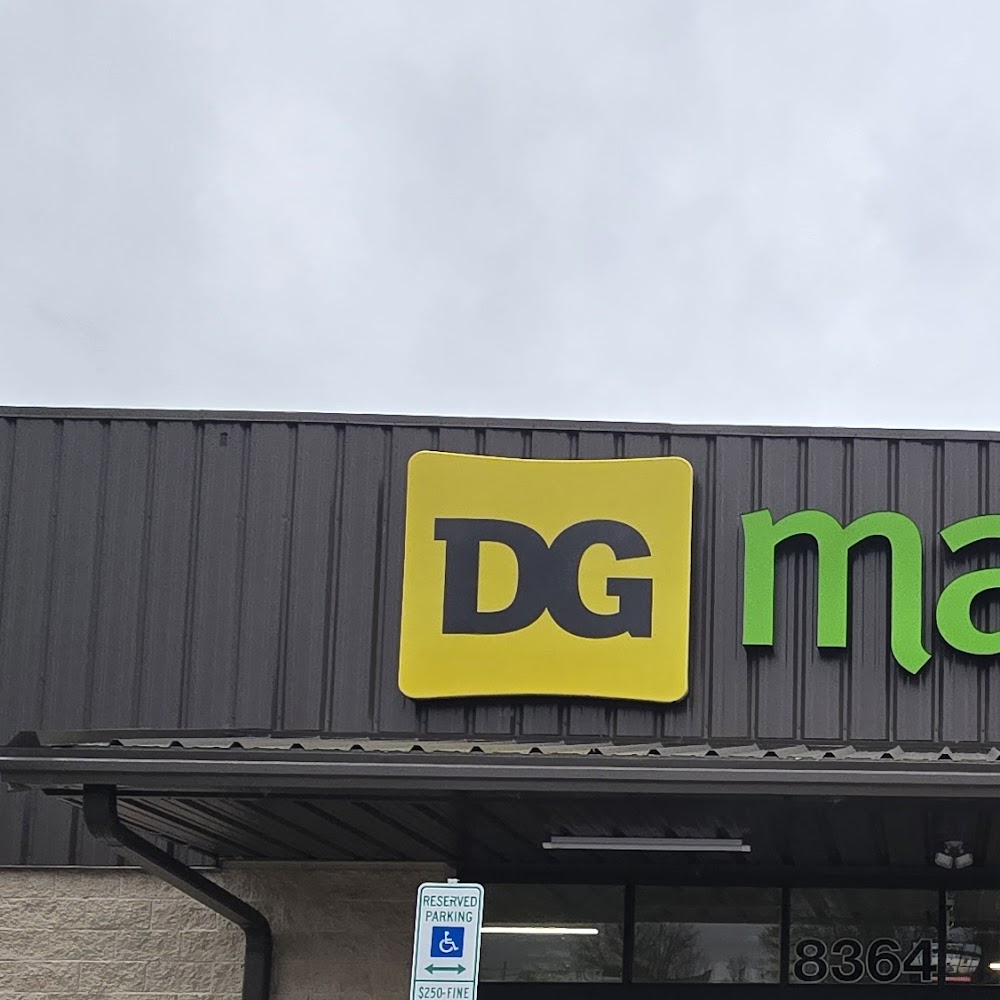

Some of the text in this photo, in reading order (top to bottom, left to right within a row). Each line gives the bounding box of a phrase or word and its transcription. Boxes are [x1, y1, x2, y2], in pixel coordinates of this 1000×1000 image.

[434, 518, 653, 639] DG
[423, 895, 478, 908] RESERVED
[425, 911, 473, 923] PARKING
[793, 937, 938, 984] 8364
